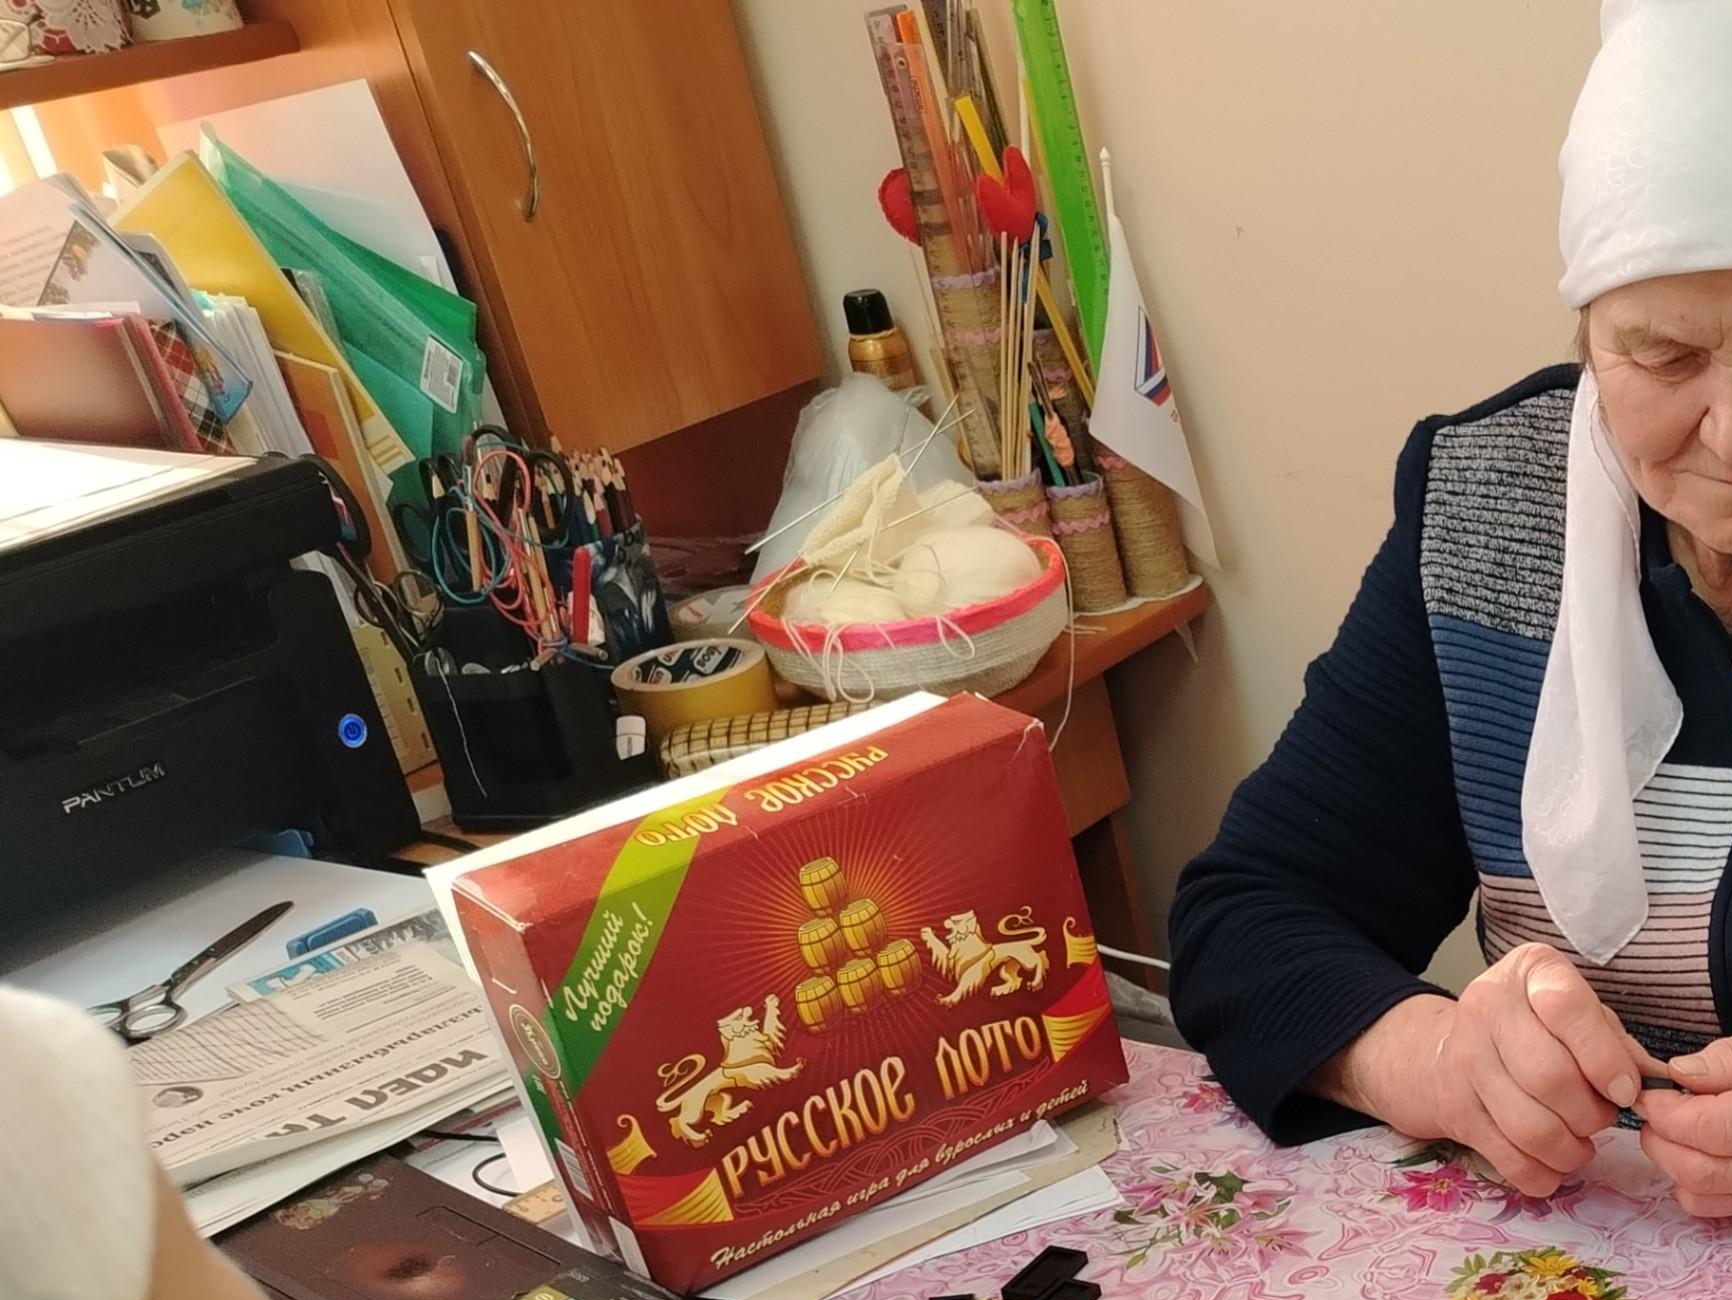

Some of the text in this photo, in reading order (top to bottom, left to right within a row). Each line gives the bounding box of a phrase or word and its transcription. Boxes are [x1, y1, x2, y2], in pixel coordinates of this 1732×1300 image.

[61, 761, 165, 814] PANTUM
[634, 745, 888, 846] РУССКОЕ ЛОТО
[563, 909, 624, 1021] Лучший
[590, 901, 653, 1031] подарок!
[348, 1049, 488, 1111] ИДЕЛ
[722, 1055, 916, 1198] РУССКОЕ
[934, 1016, 1042, 1100] ЛОТО
[710, 1077, 1090, 1269] Настольная игра для взрослых и детей
